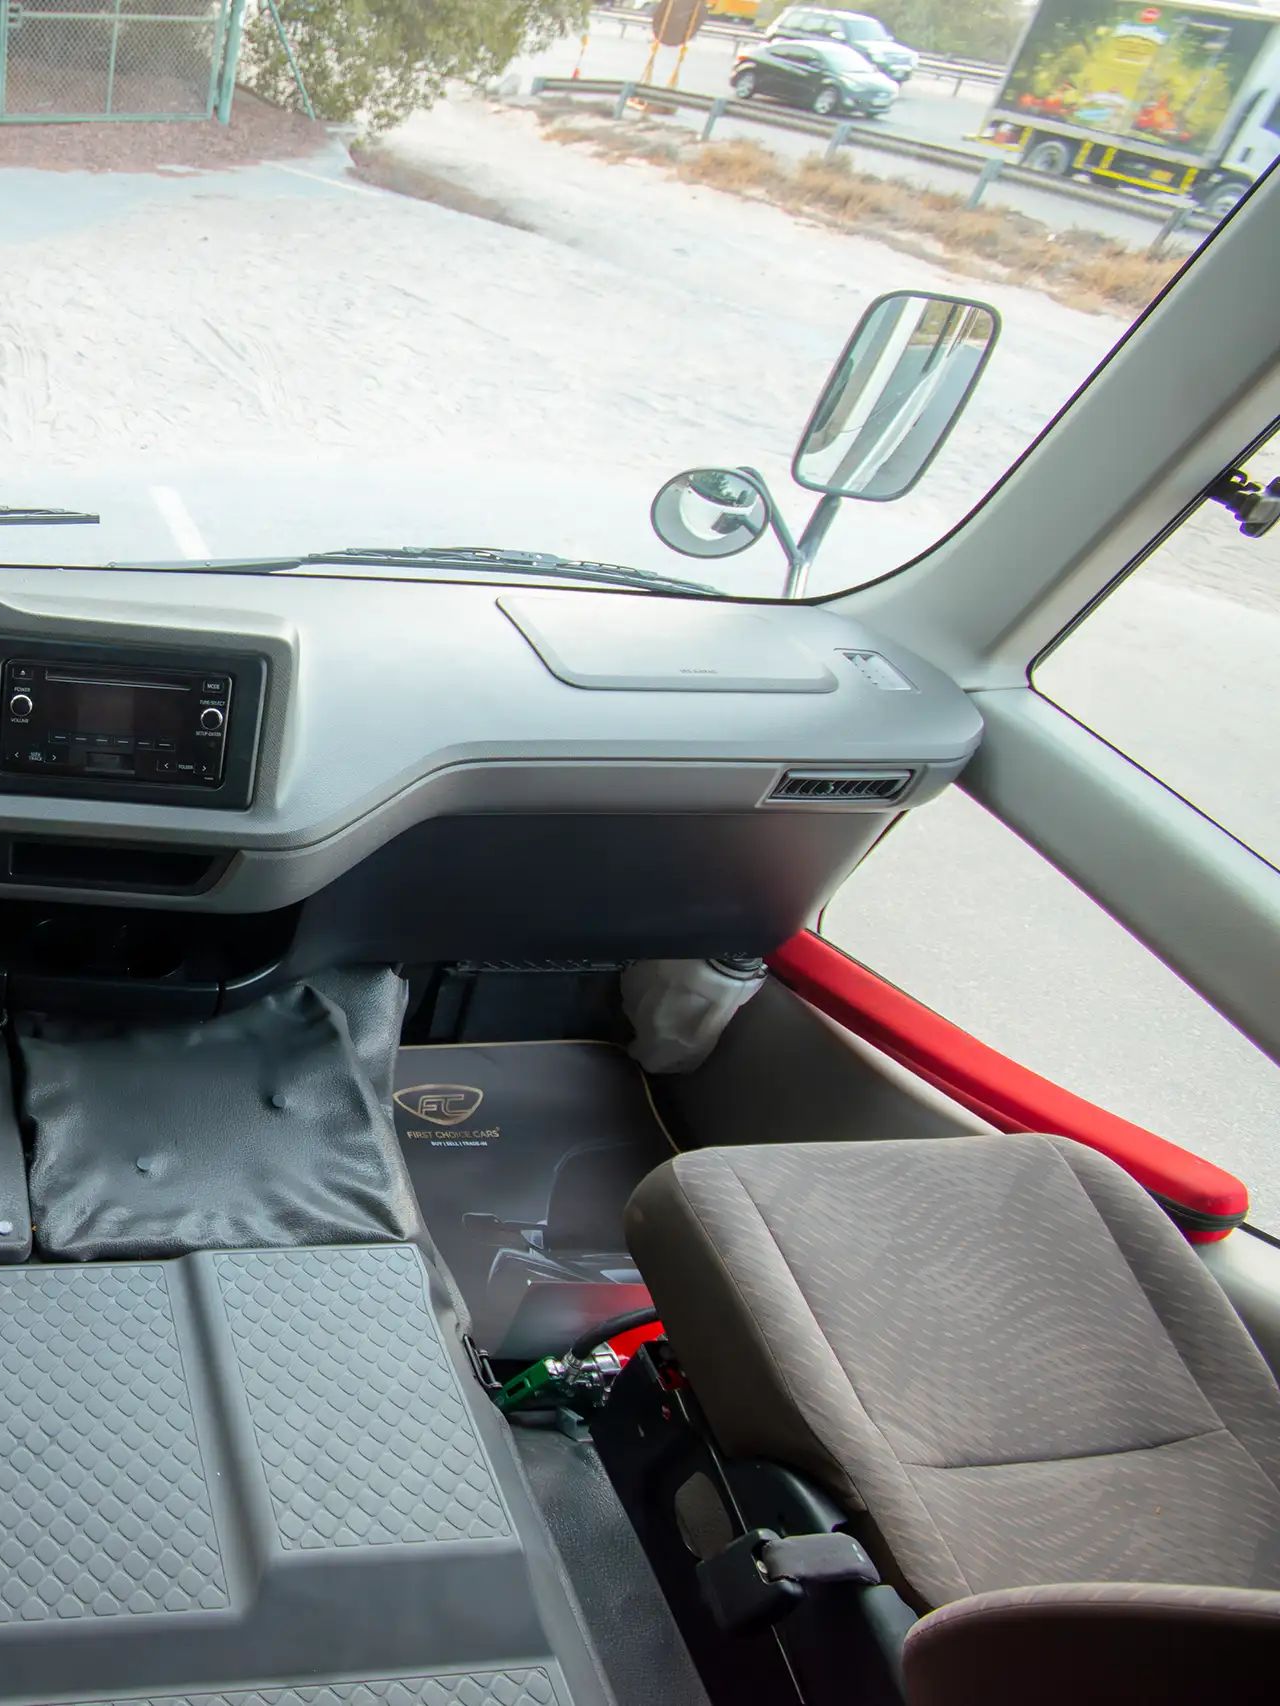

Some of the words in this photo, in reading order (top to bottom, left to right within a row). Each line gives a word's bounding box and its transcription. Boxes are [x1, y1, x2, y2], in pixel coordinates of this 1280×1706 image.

[406, 1130, 433, 1139] FIRST
[435, 1130, 472, 1139] CHOICE
[472, 1129, 500, 1139] CARS
